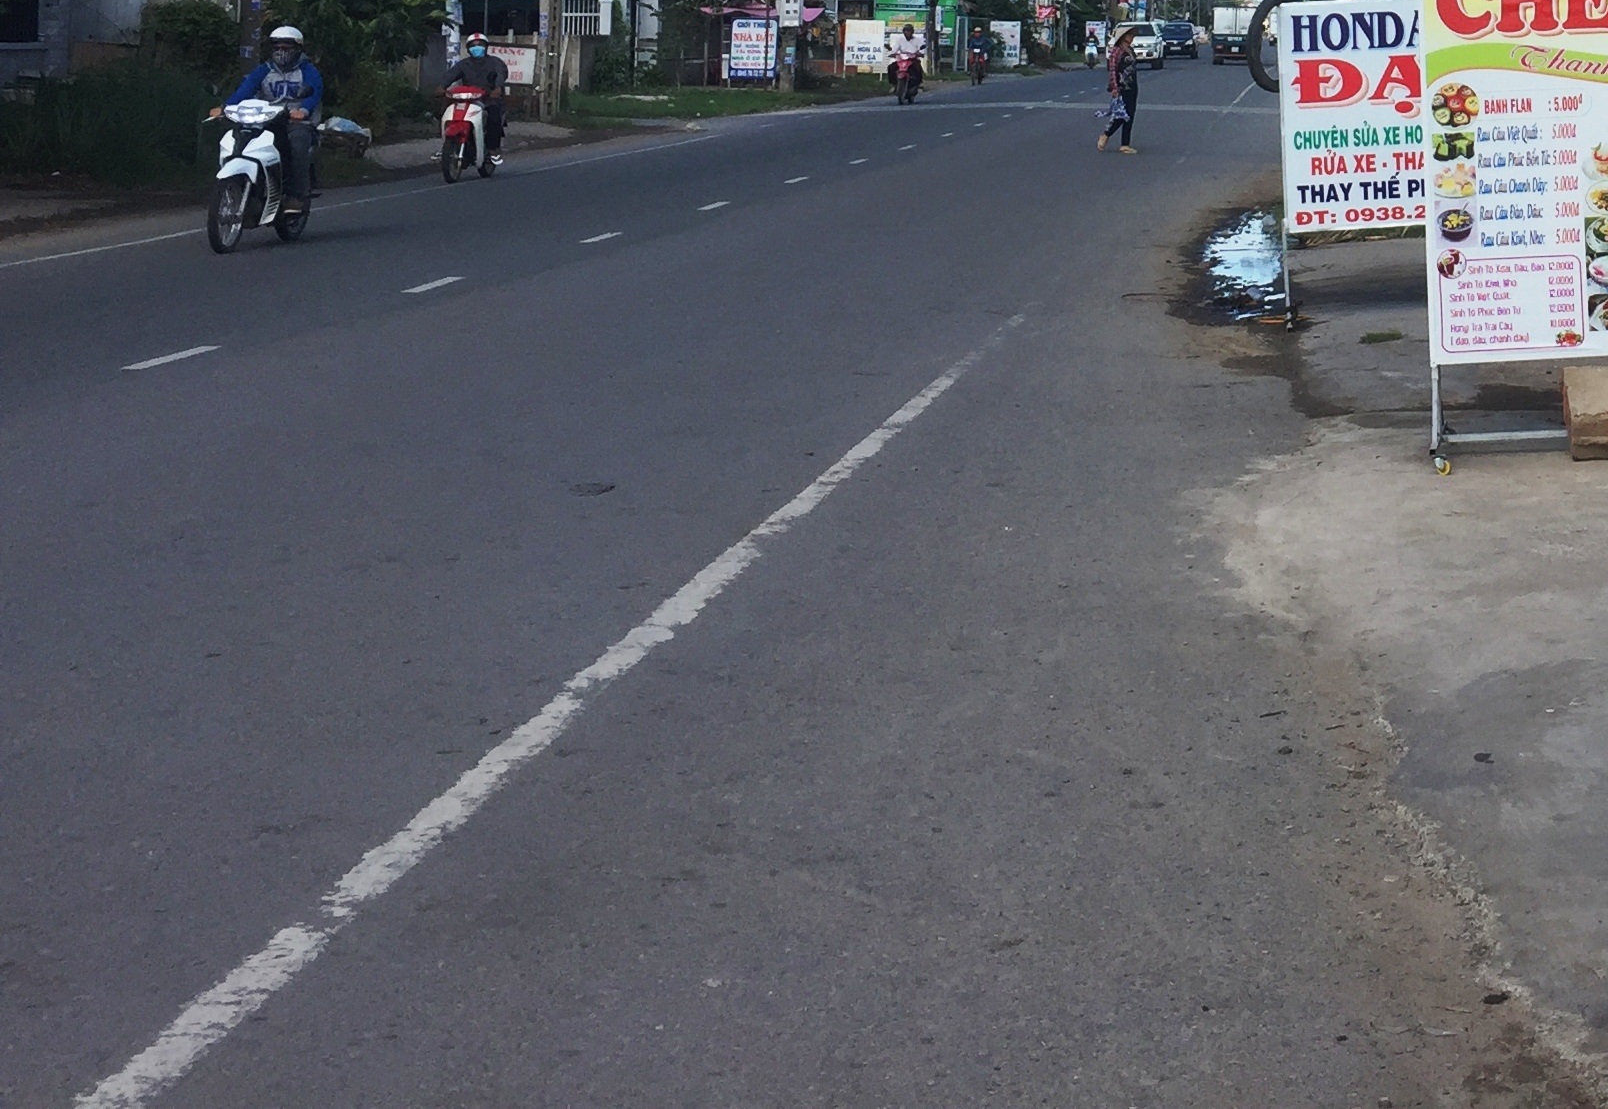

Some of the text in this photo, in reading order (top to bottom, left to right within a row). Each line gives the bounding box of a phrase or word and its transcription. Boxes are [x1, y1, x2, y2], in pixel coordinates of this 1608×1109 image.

[1511, 97, 1532, 114] FLAN
[1293, 125, 1349, 150] CHUYÊN
[1353, 121, 1380, 147] SỬA
[1383, 126, 1400, 146] XE
[1311, 149, 1348, 176] RỬA
[1353, 154, 1377, 174] XE
[1297, 182, 1353, 204] THAY
[1359, 171, 1400, 201] THẾ
[1295, 205, 1426, 226] ĐT: 0938.2
